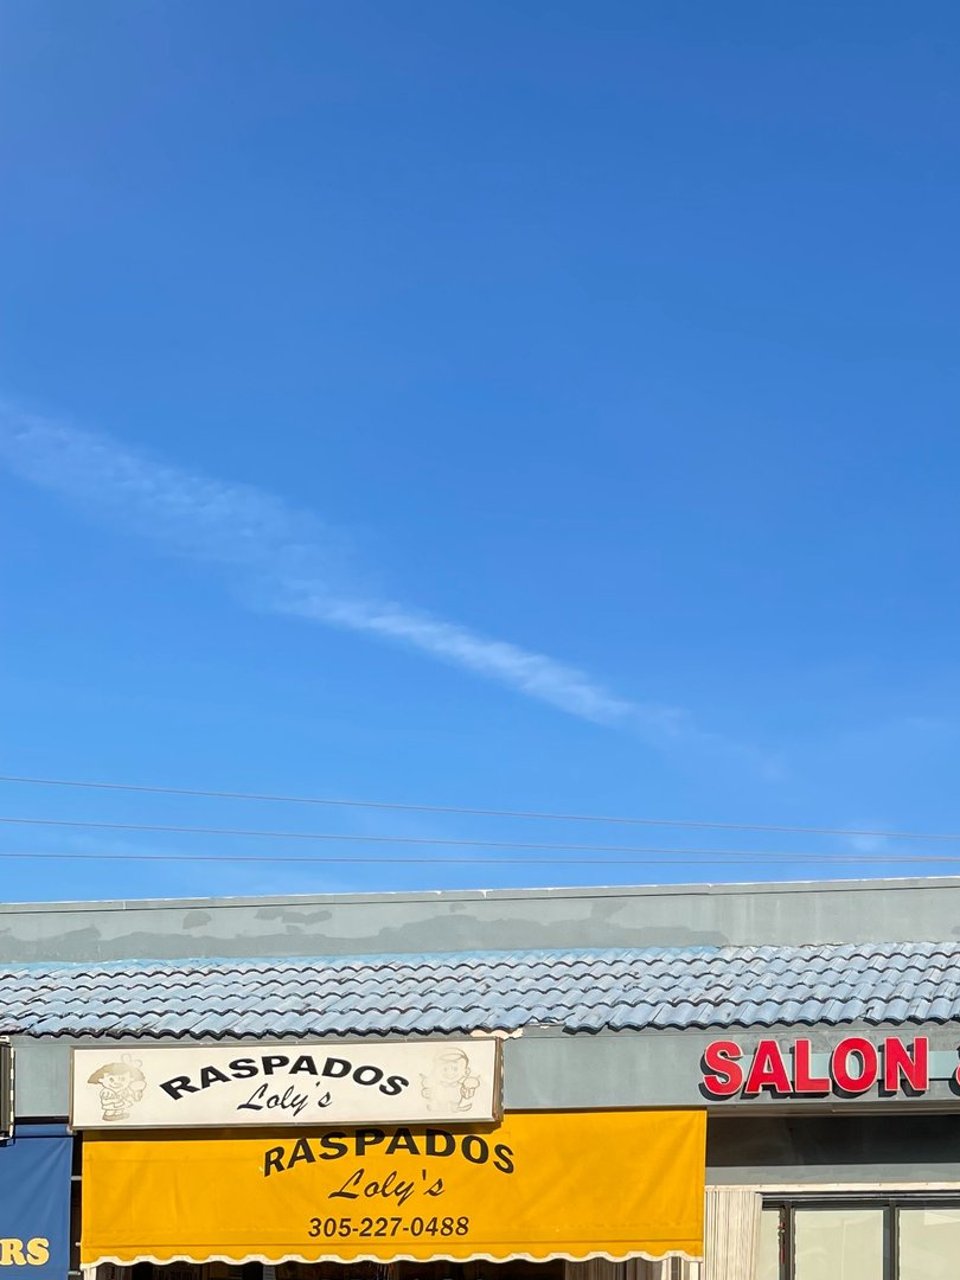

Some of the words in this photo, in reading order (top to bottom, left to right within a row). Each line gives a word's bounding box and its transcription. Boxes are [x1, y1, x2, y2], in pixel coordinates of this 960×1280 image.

[159, 1055, 410, 1101] RASPADOS
[703, 1036, 929, 1095] SALON
[236, 1081, 334, 1118] Loly's
[263, 1128, 515, 1177] RASPADOS
[328, 1168, 445, 1206] Loly's
[308, 1216, 470, 1238] 305-227-0488
